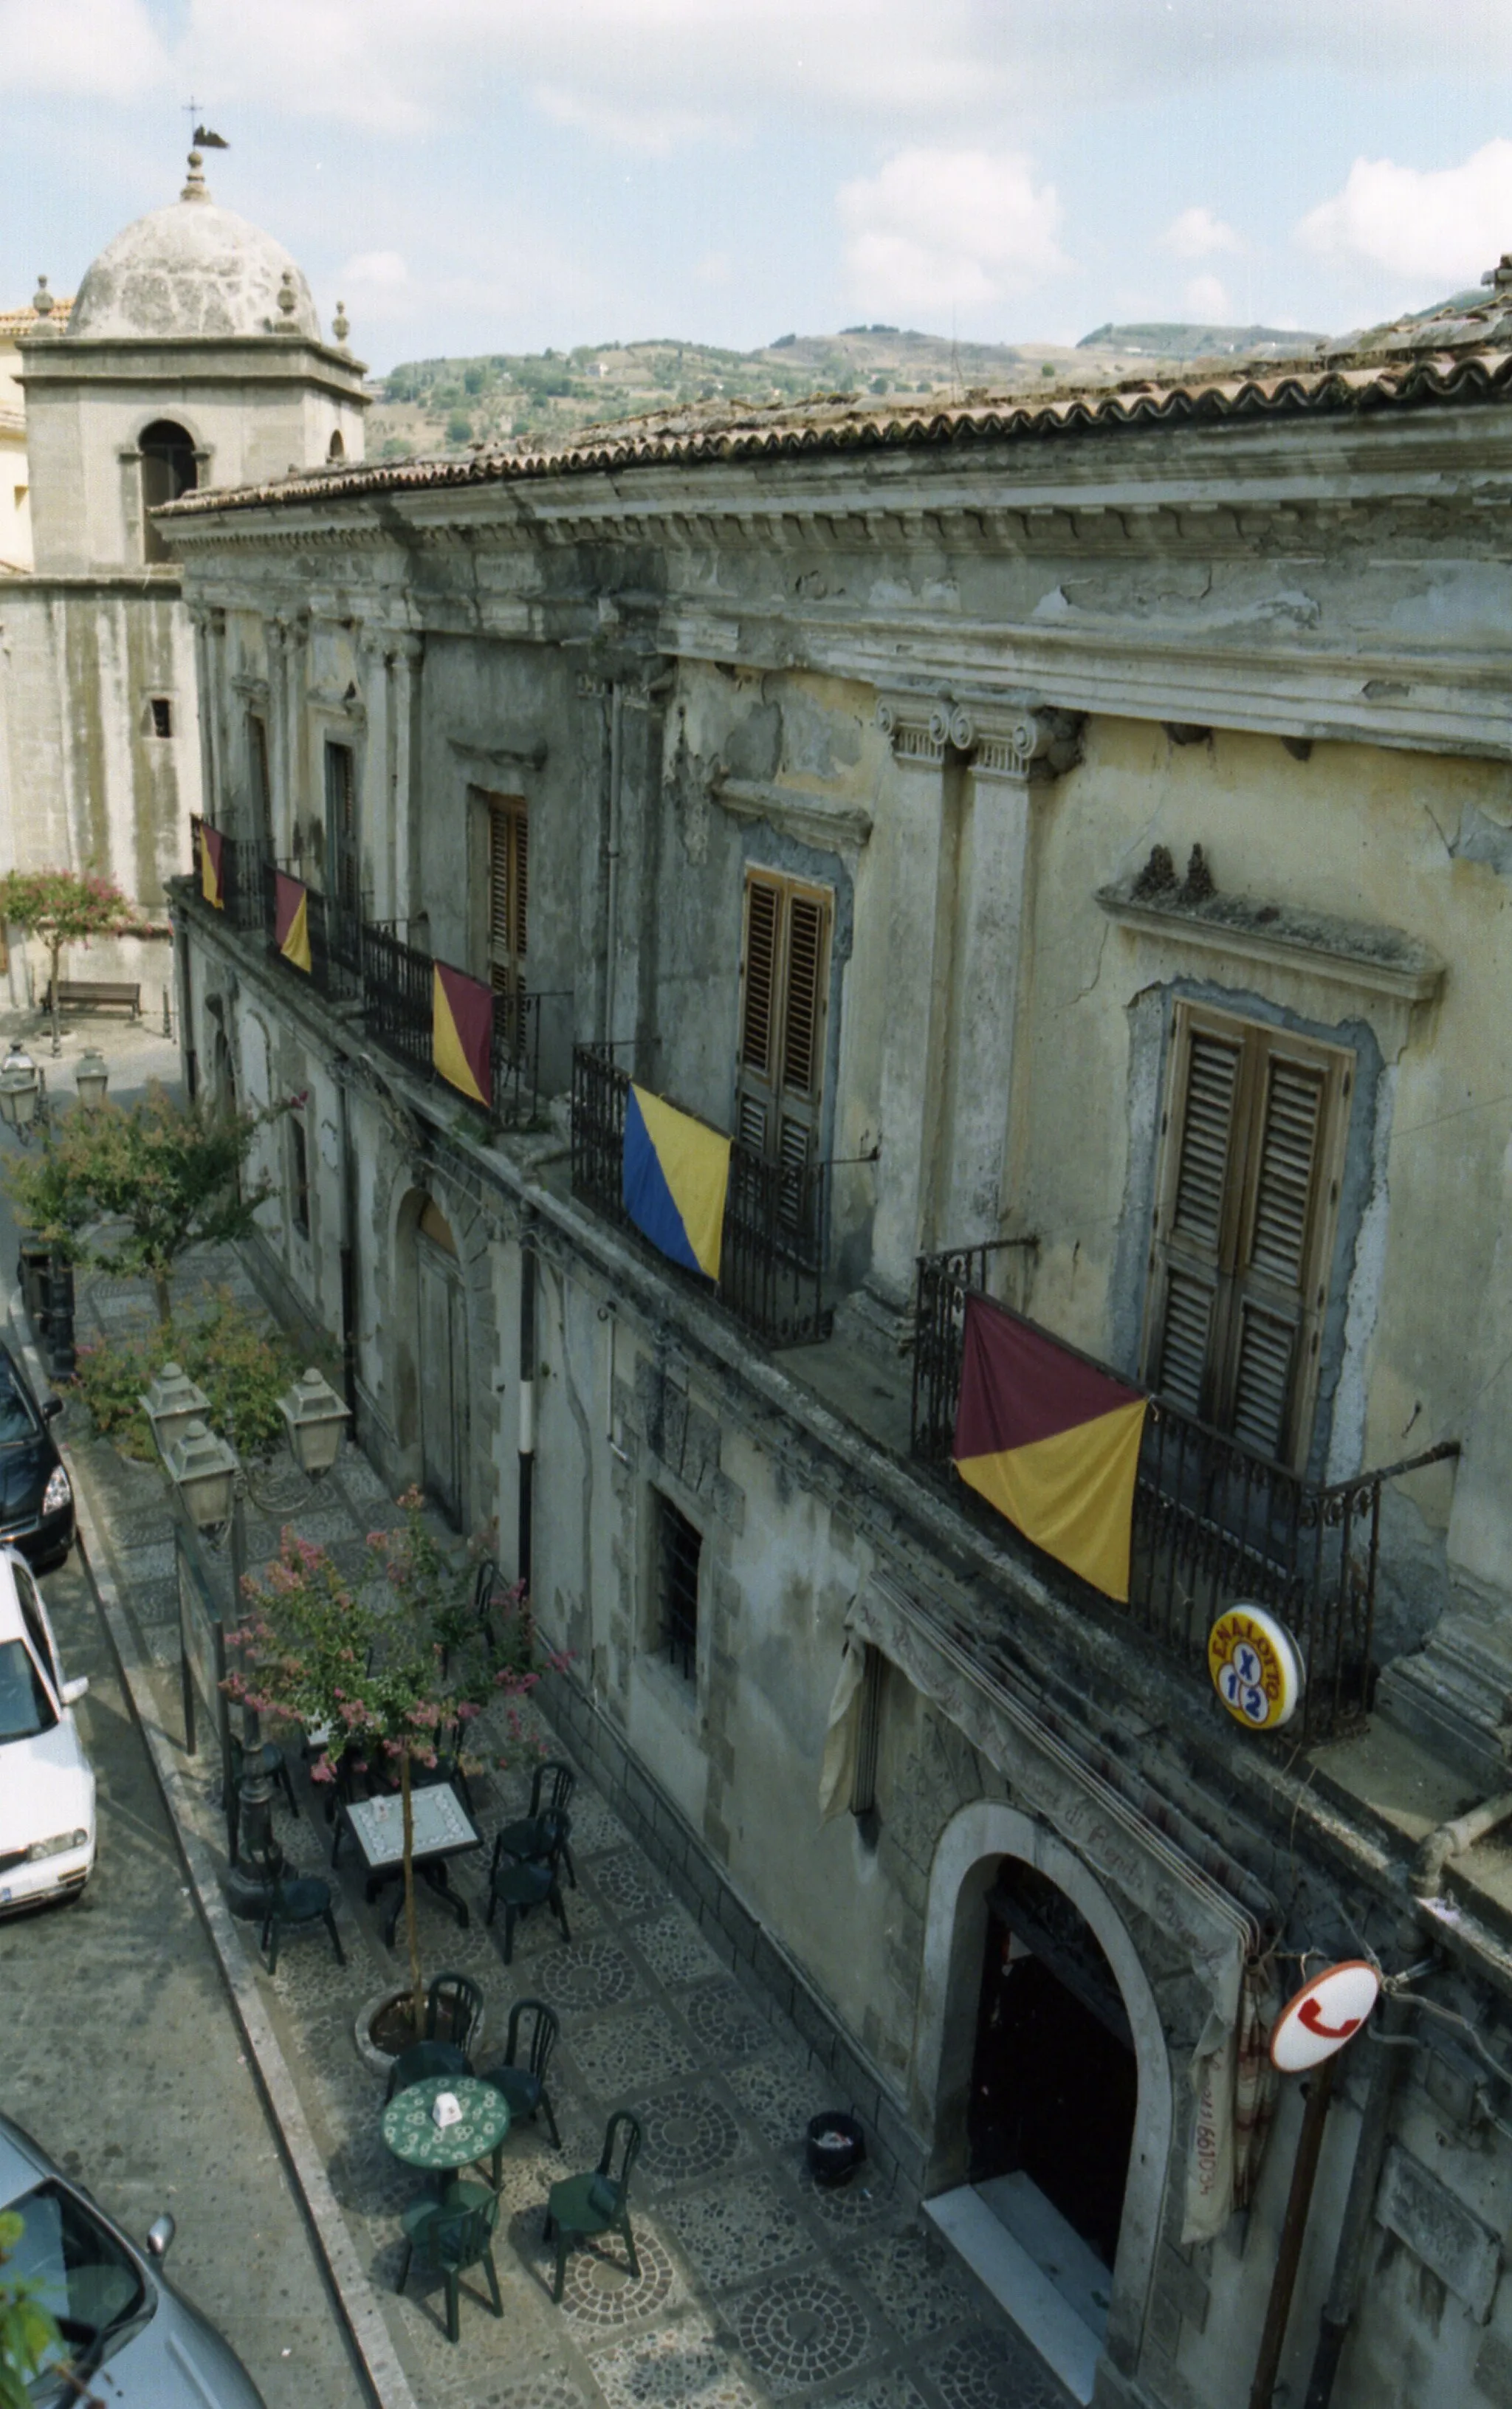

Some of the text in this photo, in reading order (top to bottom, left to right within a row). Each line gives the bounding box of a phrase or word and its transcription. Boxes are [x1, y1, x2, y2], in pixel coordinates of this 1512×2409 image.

[1212, 1617, 1280, 1700] ENALOTTO
[1228, 1674, 1237, 1700] 1
[1245, 1690, 1261, 1718] 2
